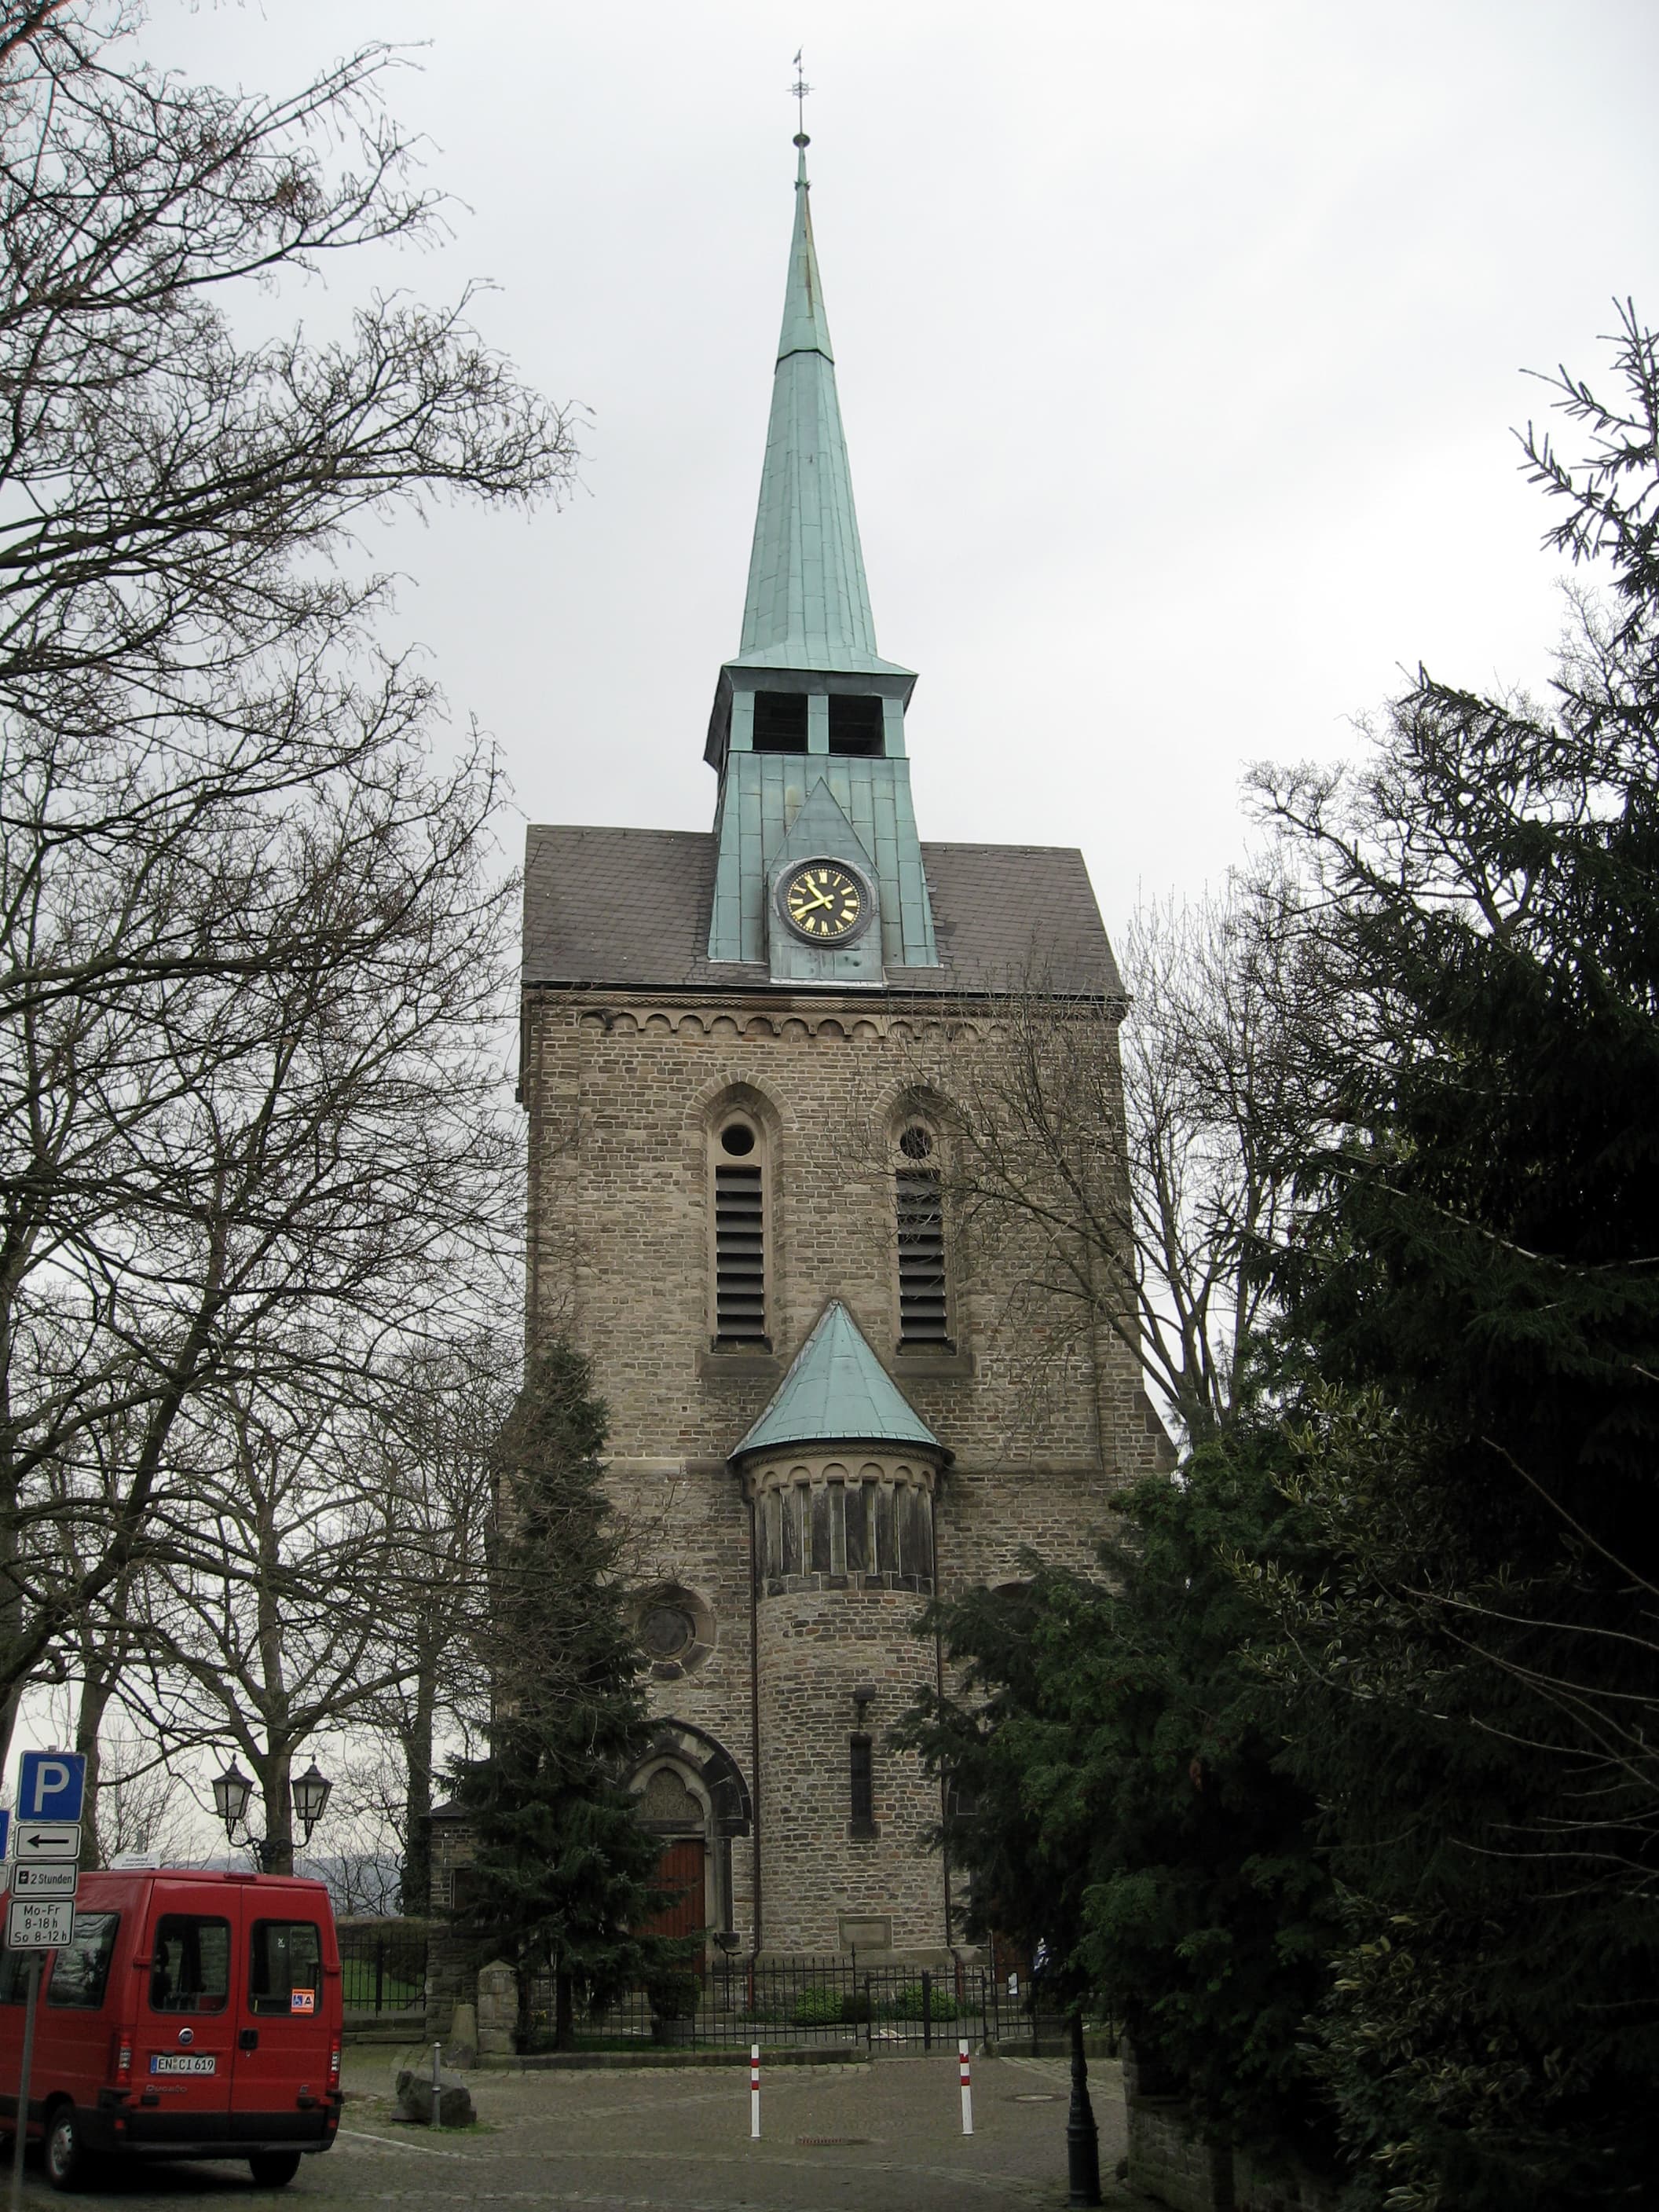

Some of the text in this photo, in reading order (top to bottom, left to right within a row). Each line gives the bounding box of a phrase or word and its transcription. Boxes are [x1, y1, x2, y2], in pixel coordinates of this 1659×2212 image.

[34, 1761, 70, 1812] P
[31, 1873, 72, 1884] 2 Stunden
[24, 1904, 60, 1915] Mo-Fr
[25, 1917, 57, 1929] 8-18 h
[14, 1930, 67, 1943] So 8-12 h
[158, 2059, 173, 2070] EN
[195, 2060, 214, 2071] 619
